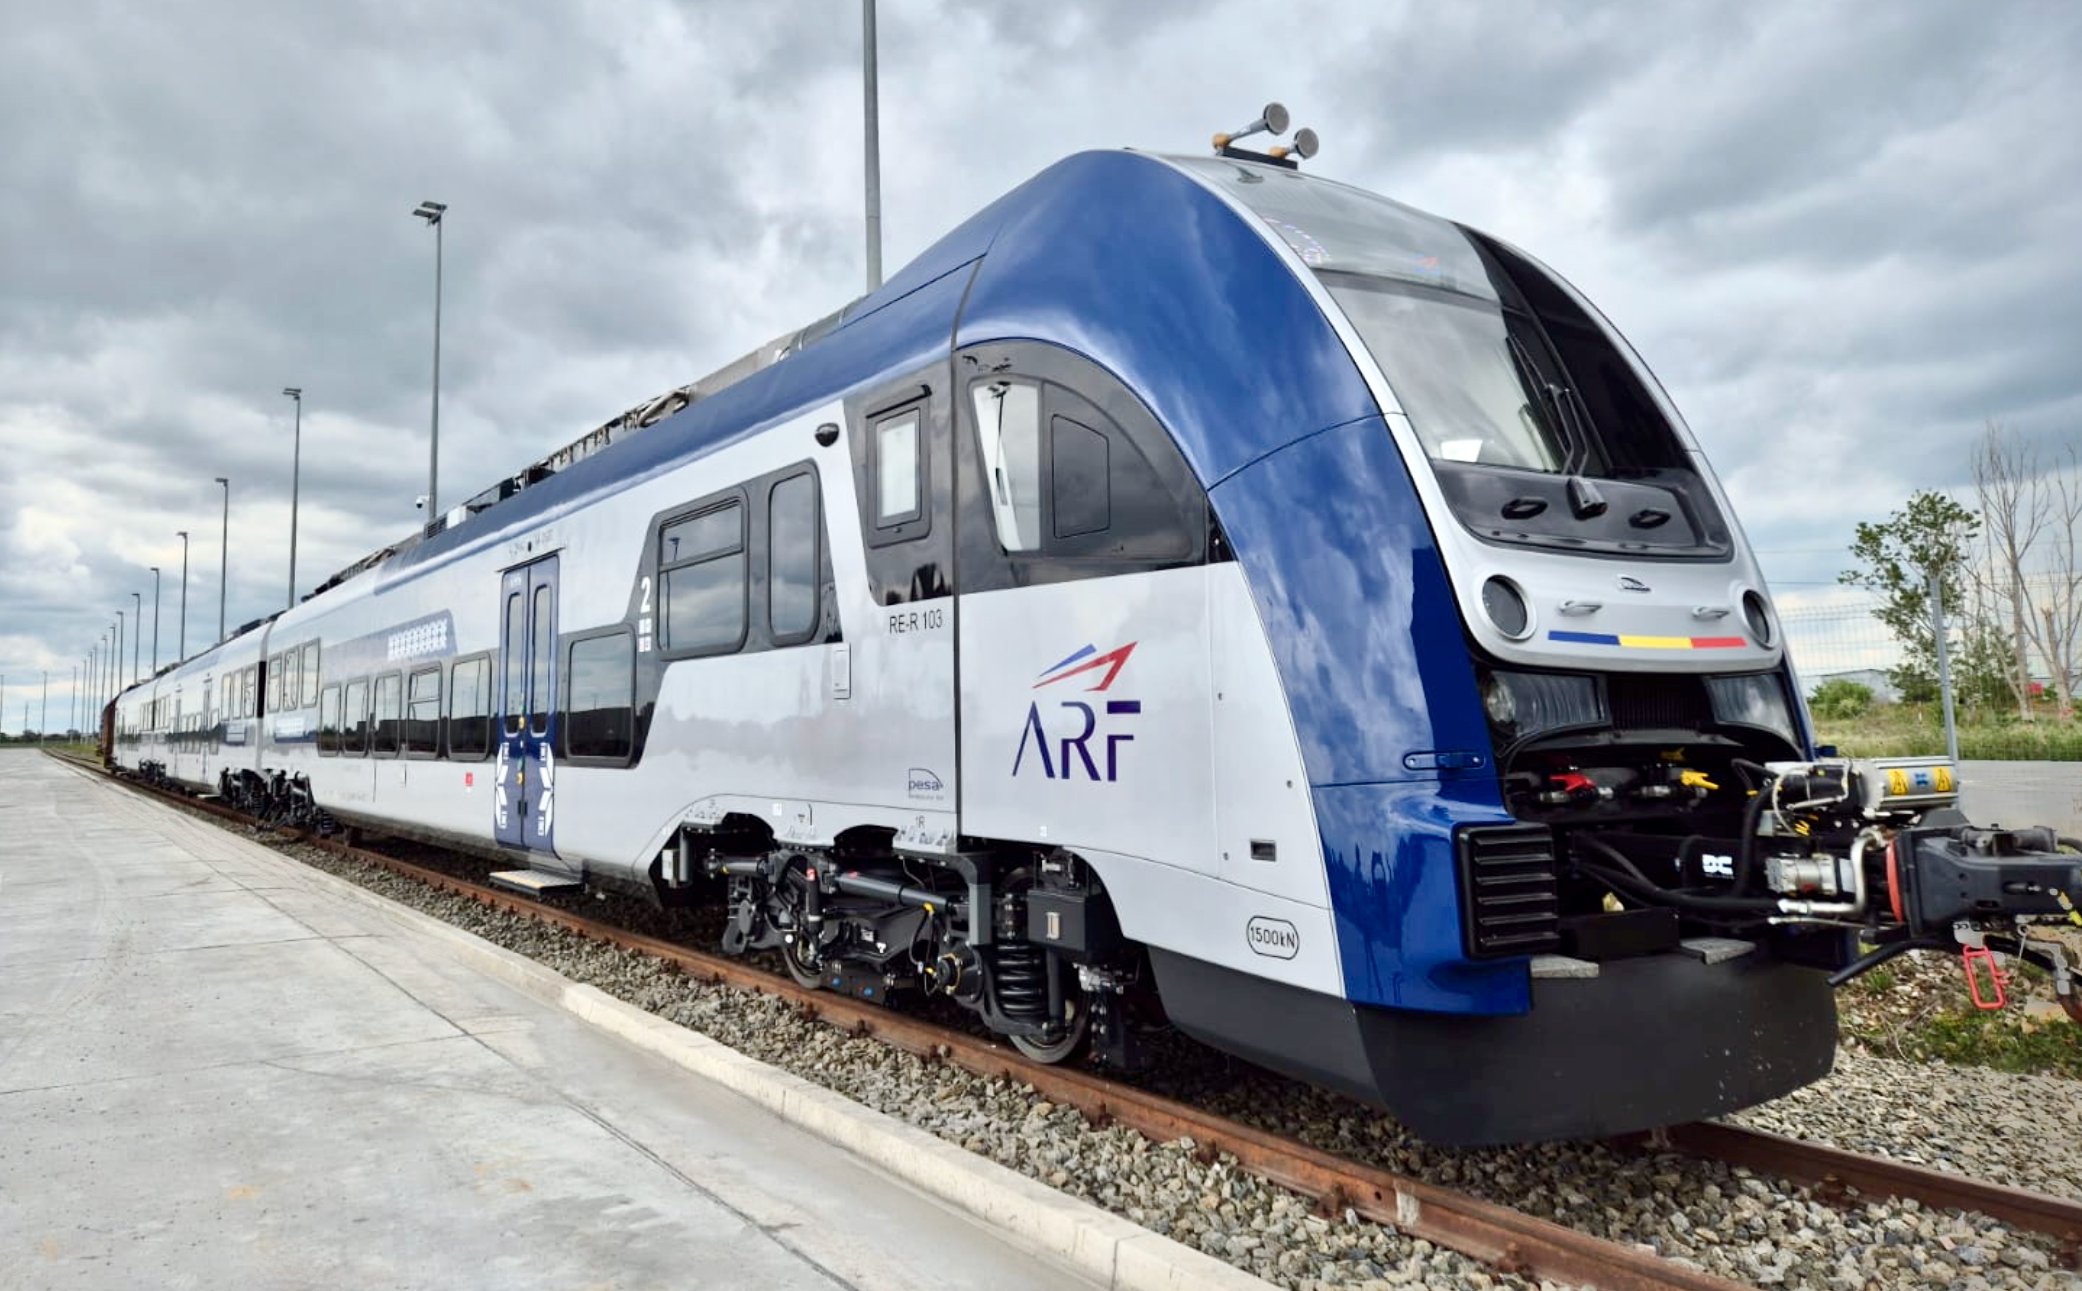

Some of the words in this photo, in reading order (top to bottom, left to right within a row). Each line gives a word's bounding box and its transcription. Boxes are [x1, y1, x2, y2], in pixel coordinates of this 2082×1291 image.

[641, 576, 651, 614] 2
[889, 612, 919, 634] RE-R
[923, 609, 943, 630] 103
[1012, 700, 1141, 782] ARF
[908, 780, 940, 792] pesa
